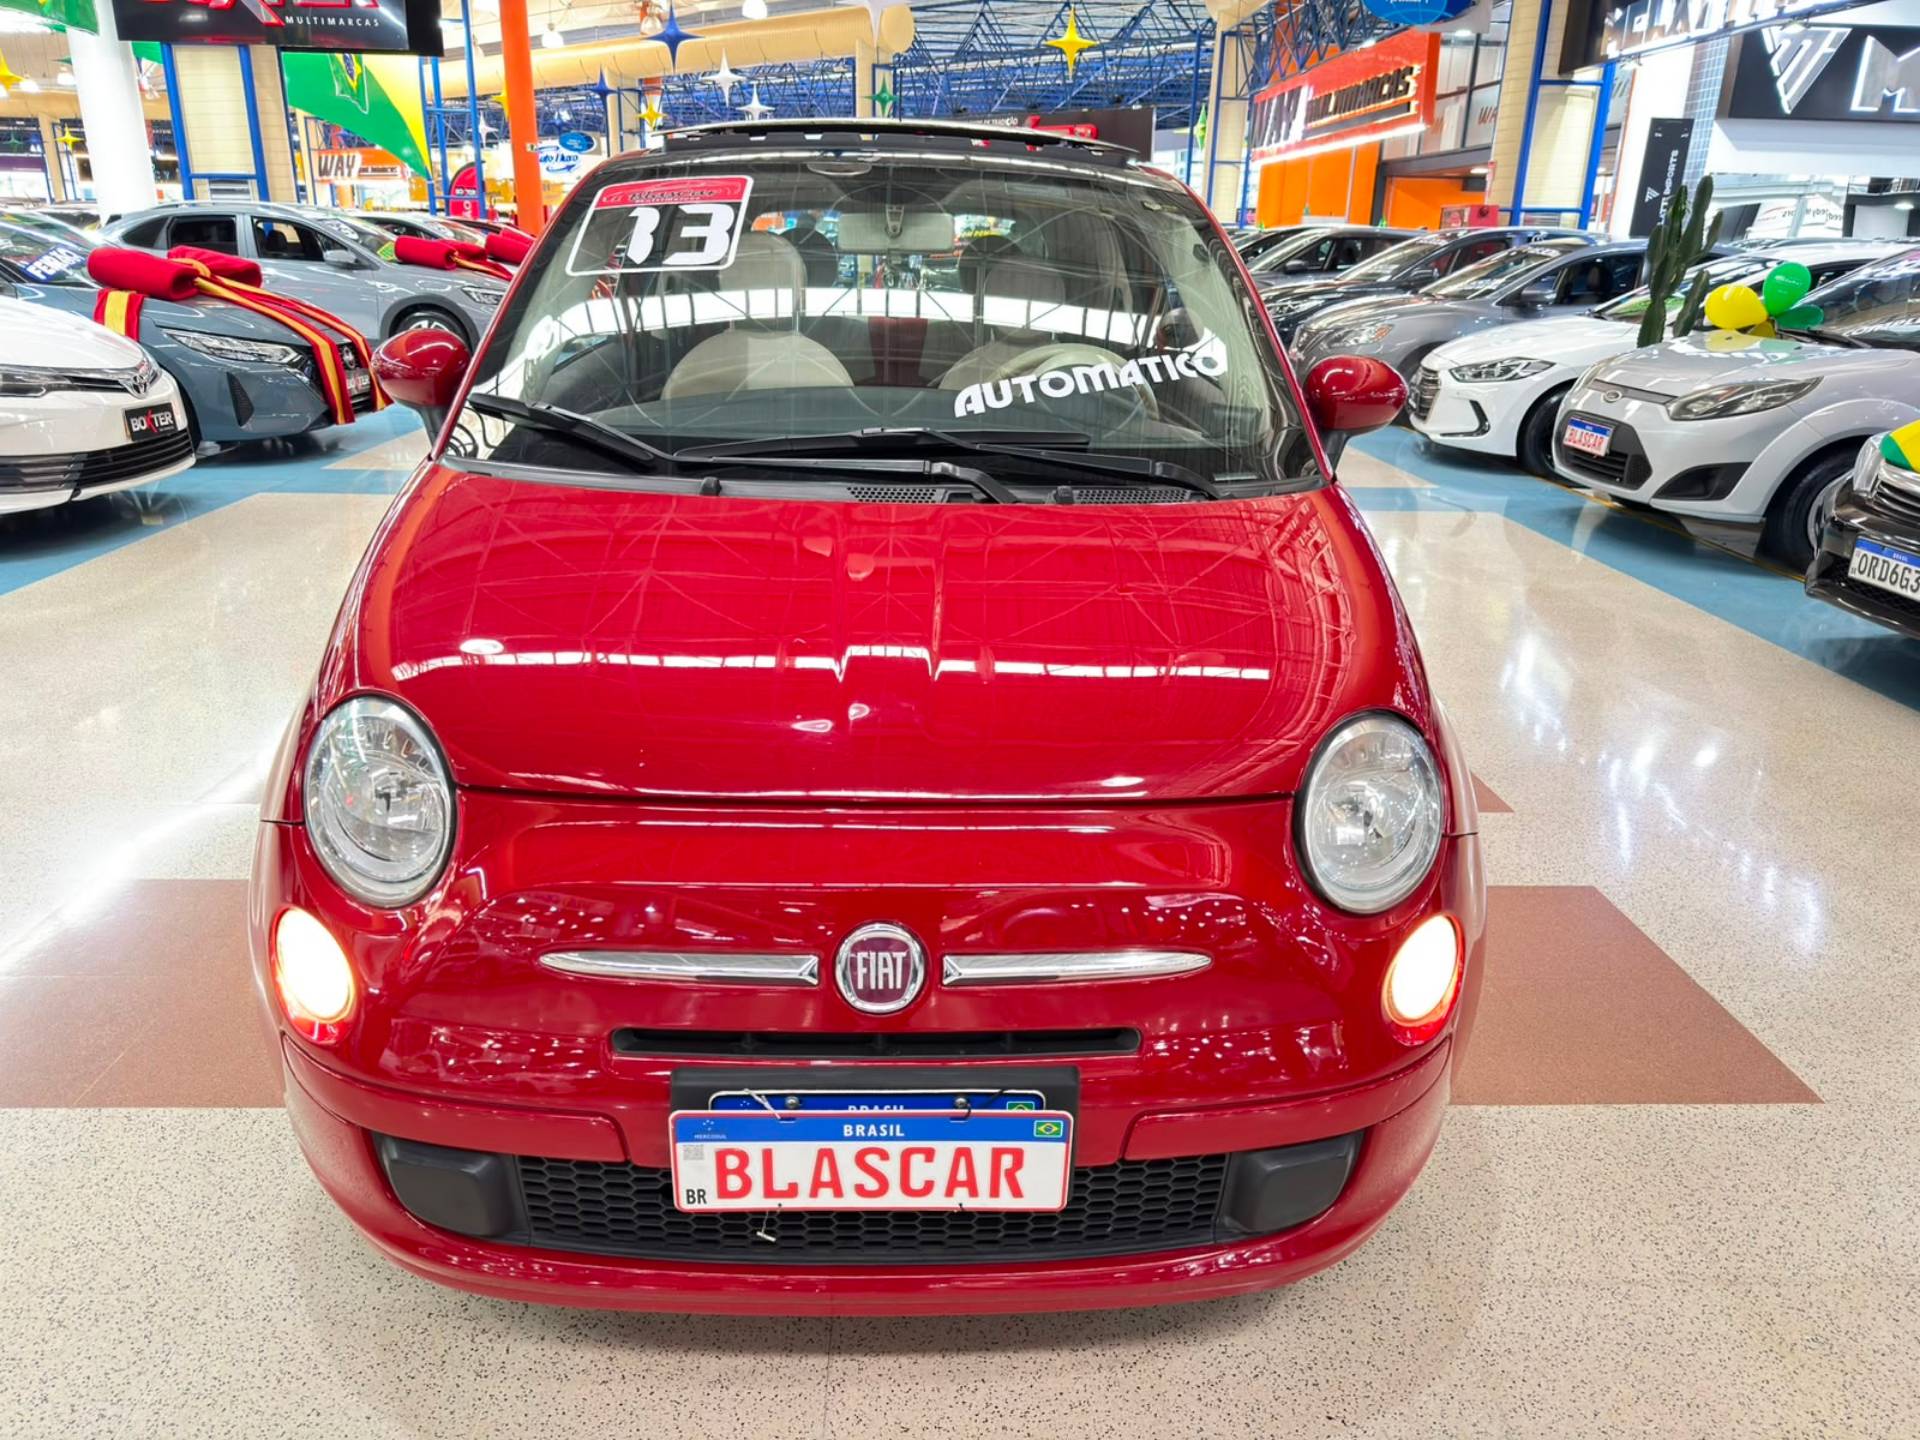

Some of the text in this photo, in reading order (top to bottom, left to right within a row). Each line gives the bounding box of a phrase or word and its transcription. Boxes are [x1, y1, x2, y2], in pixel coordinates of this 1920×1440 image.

[285, 15, 379, 27] MULTIMARCAS
[319, 154, 356, 177] WAY
[626, 203, 735, 265] 13
[130, 408, 174, 434] BOXTER
[857, 951, 907, 990] FIAT
[843, 1123, 905, 1137] BRASIL
[714, 1146, 1025, 1200] BLASCAR
[686, 1189, 707, 1204] BR
